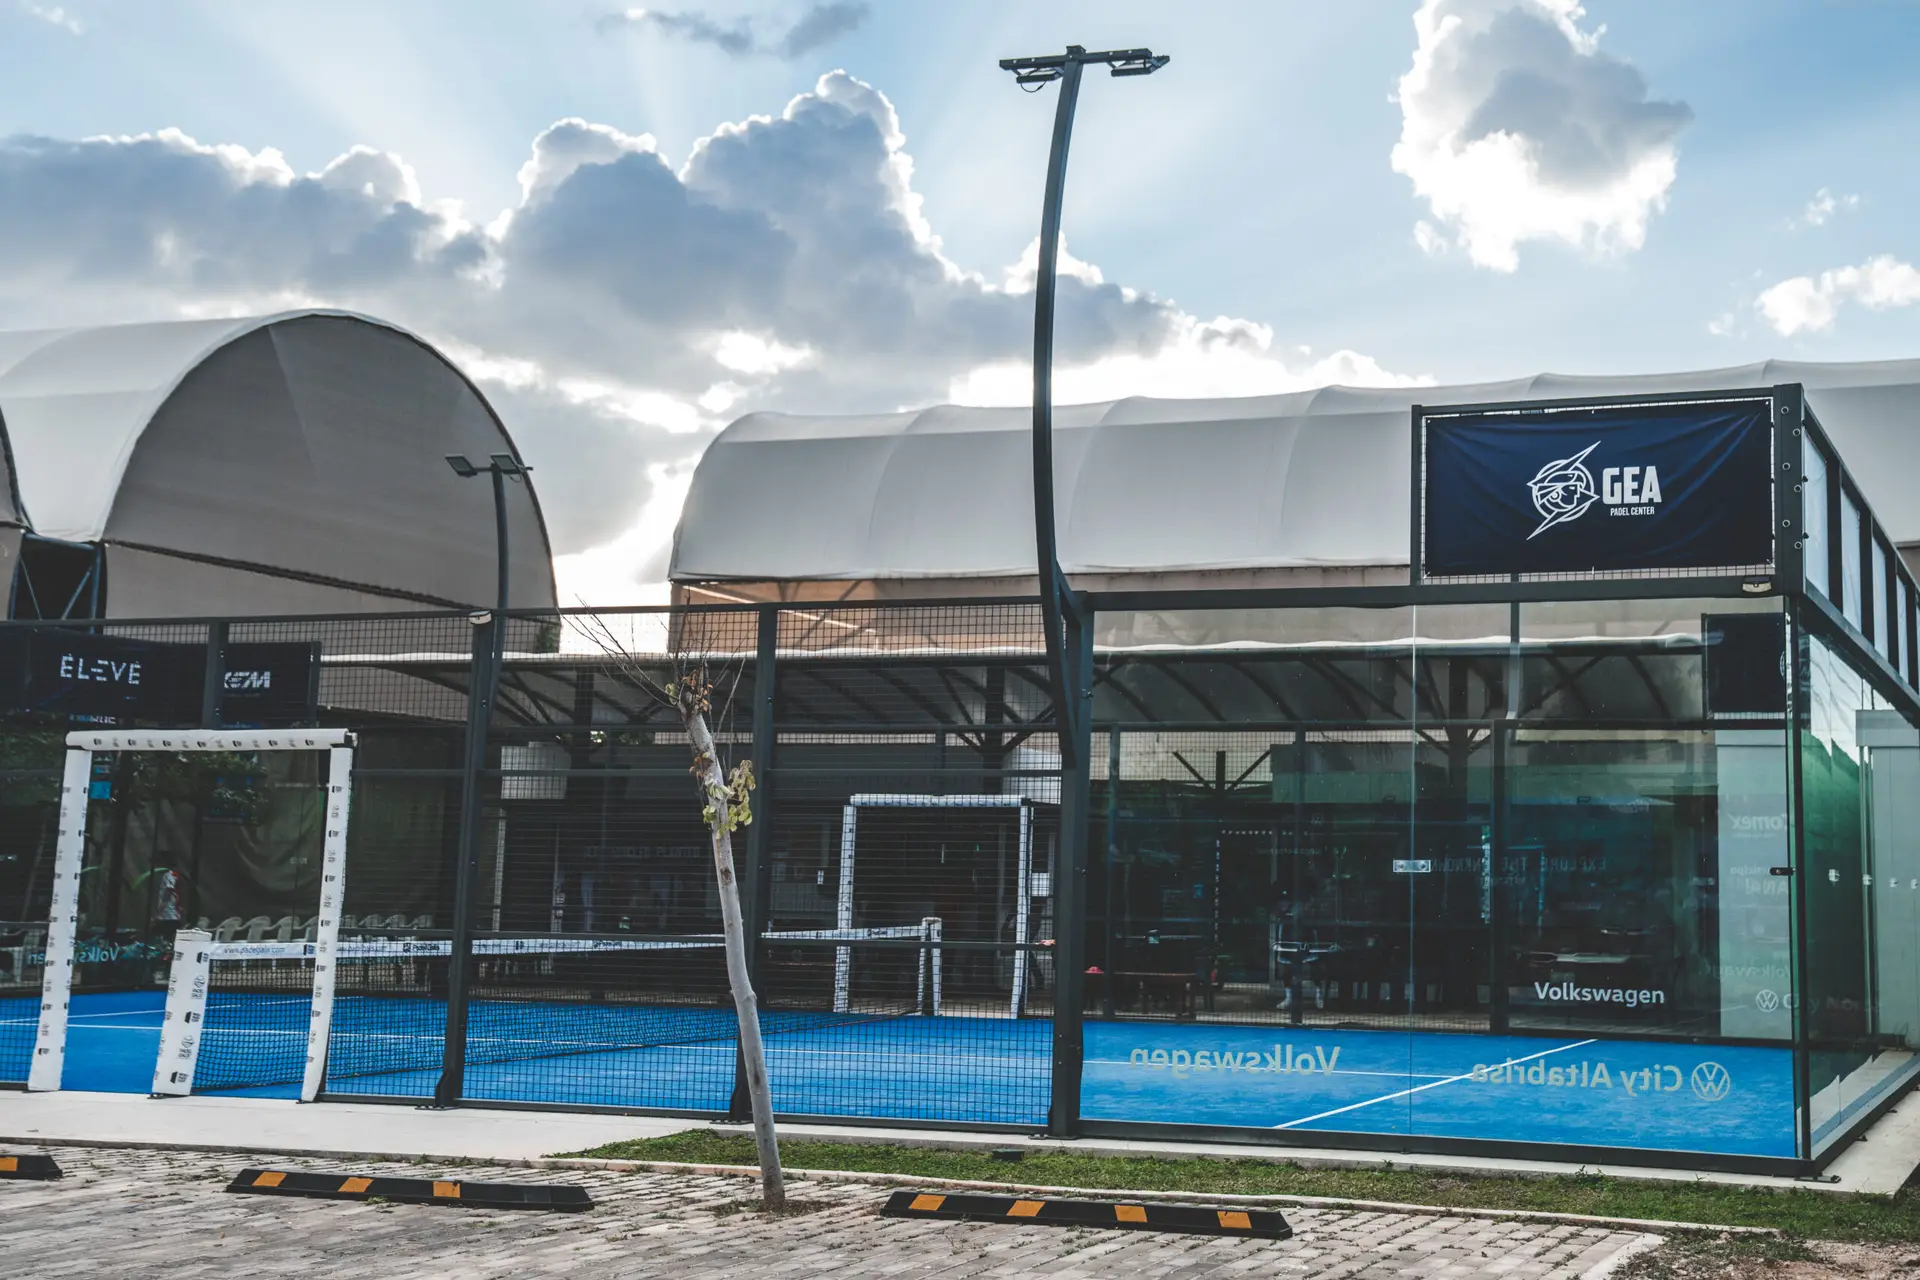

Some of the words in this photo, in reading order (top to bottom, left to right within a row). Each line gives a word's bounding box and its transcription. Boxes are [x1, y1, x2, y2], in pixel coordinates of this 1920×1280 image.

[1602, 465, 1662, 504] GEA
[1610, 507, 1630, 517] PADEL
[1630, 506, 1655, 517] CENTER
[1534, 981, 1665, 1009] Volkswagen
